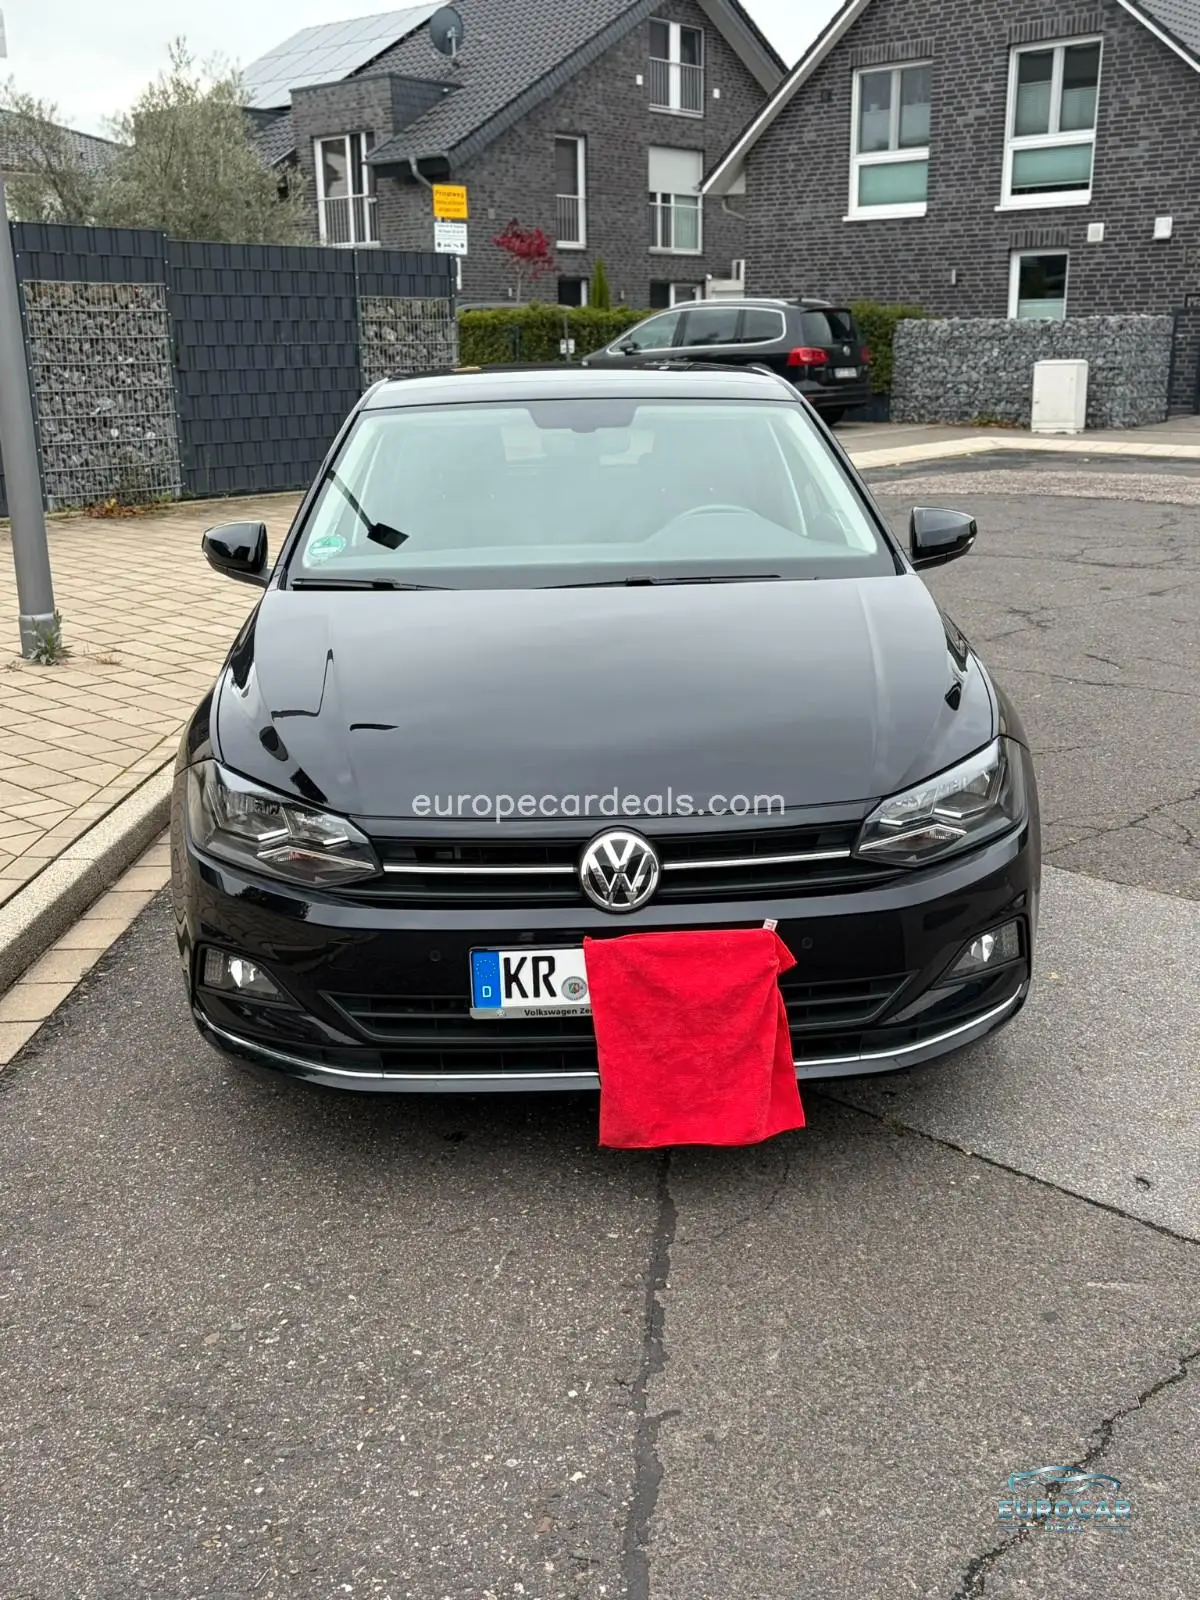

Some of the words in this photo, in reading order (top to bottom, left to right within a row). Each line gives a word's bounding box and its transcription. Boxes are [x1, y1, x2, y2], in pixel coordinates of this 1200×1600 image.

[482, 985, 492, 998] D
[503, 955, 557, 998] KR
[524, 1007, 578, 1017] Volkswagen
